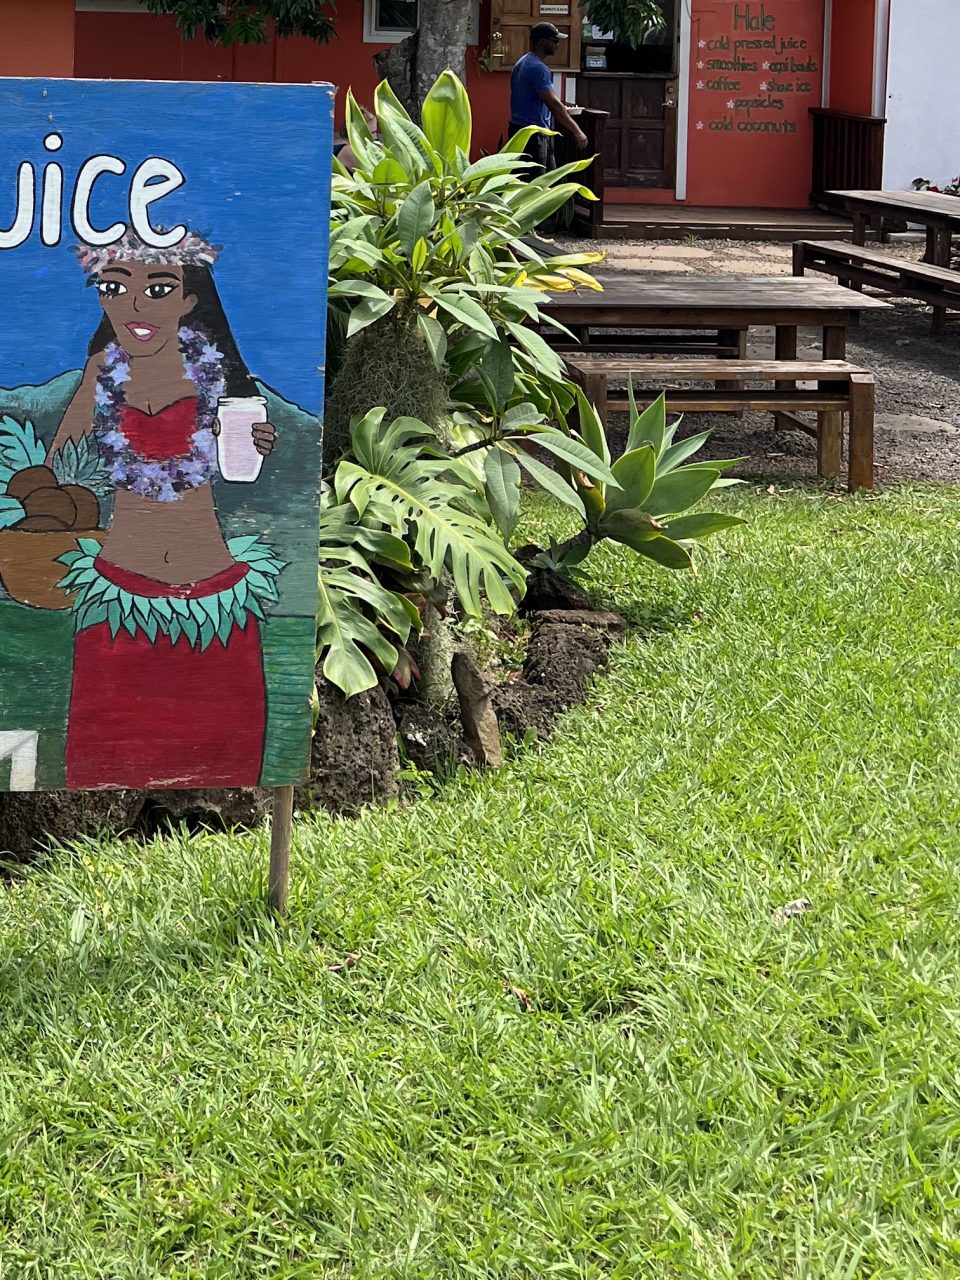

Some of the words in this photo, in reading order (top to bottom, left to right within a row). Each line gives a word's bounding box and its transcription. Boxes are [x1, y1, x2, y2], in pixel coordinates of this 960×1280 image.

[734, 4, 776, 31] Hale
[707, 35, 730, 51] cold
[734, 35, 776, 54] pressed
[775, 37, 807, 55] juice
[706, 56, 758, 72] smoothies
[705, 76, 741, 92] coffee
[735, 94, 784, 117] popsicles
[709, 116, 732, 132] cold
[737, 120, 797, 133] coconuts
